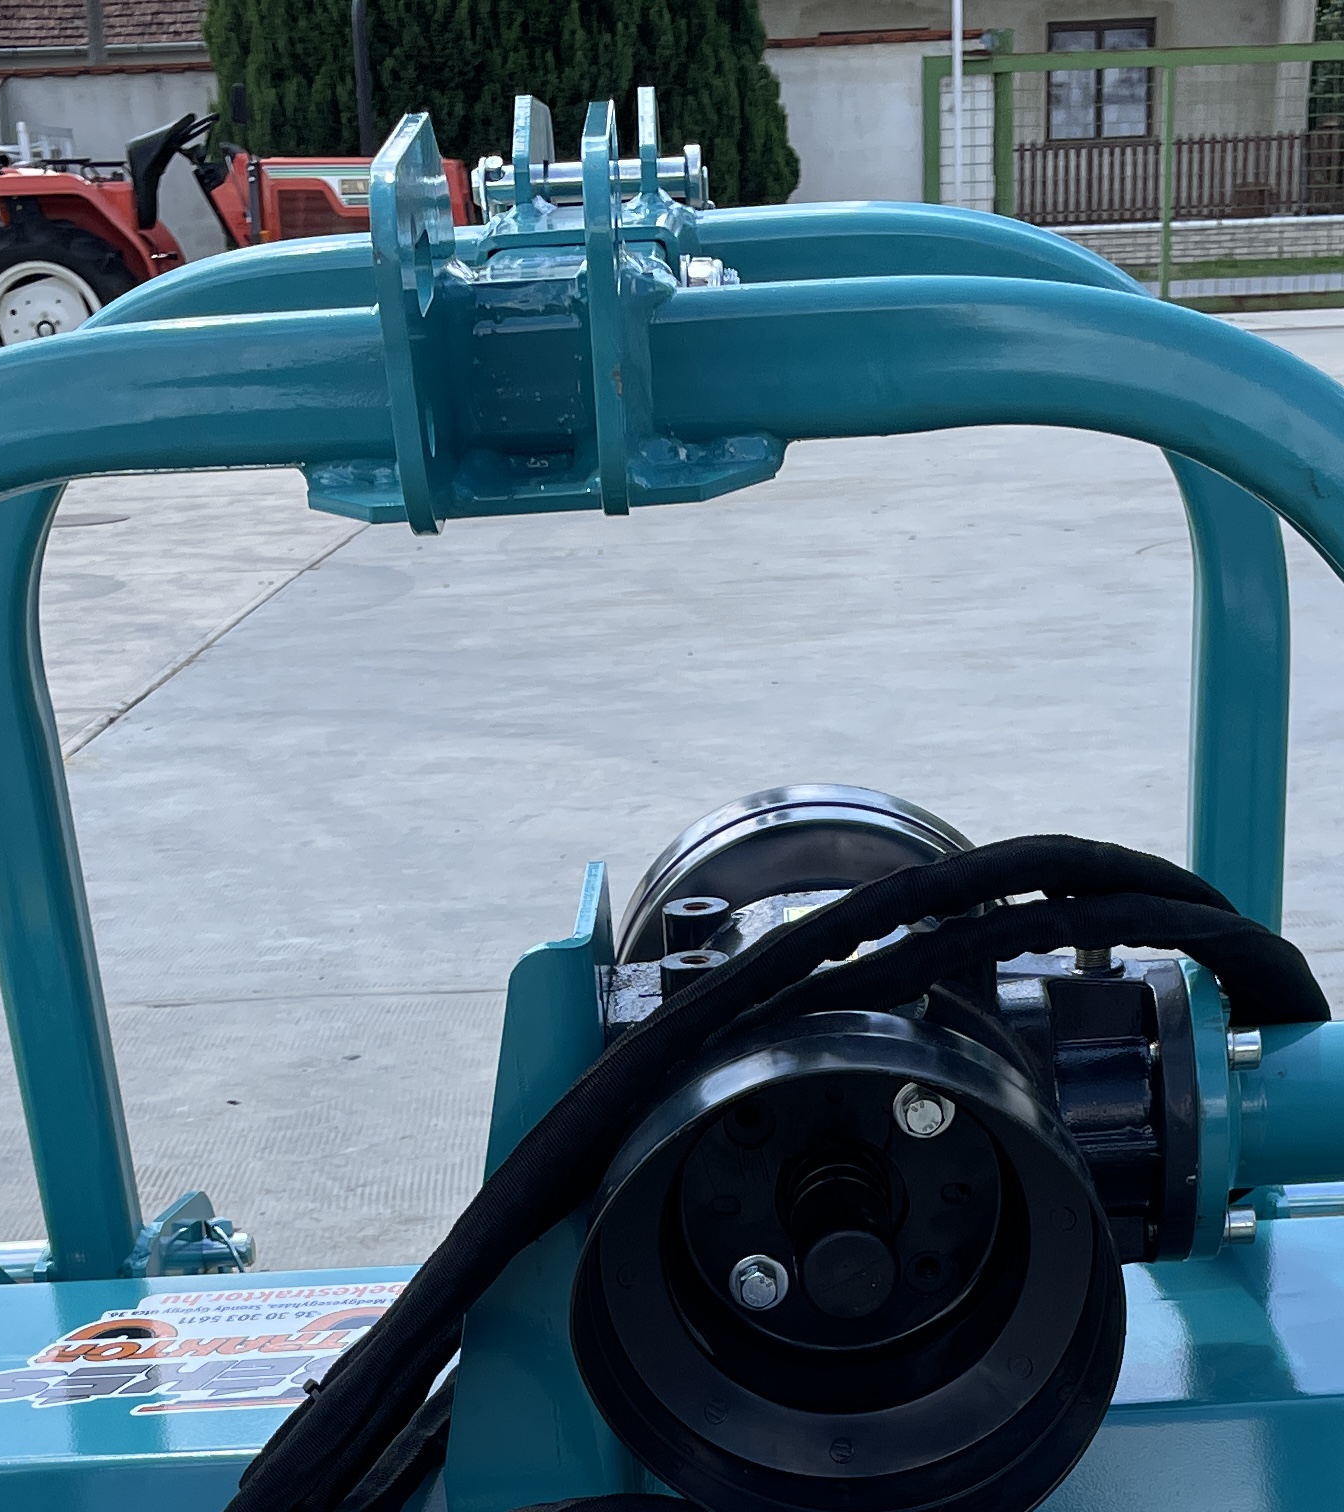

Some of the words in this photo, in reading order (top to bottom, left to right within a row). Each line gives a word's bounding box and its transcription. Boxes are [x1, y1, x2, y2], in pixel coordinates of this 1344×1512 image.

[213, 1304, 262, 1313] Szondy
[178, 1315, 223, 1325] 5611
[226, 1313, 263, 1322] 303
[265, 1311, 290, 1320] 30
[34, 1331, 351, 1364] TRAKTOR
